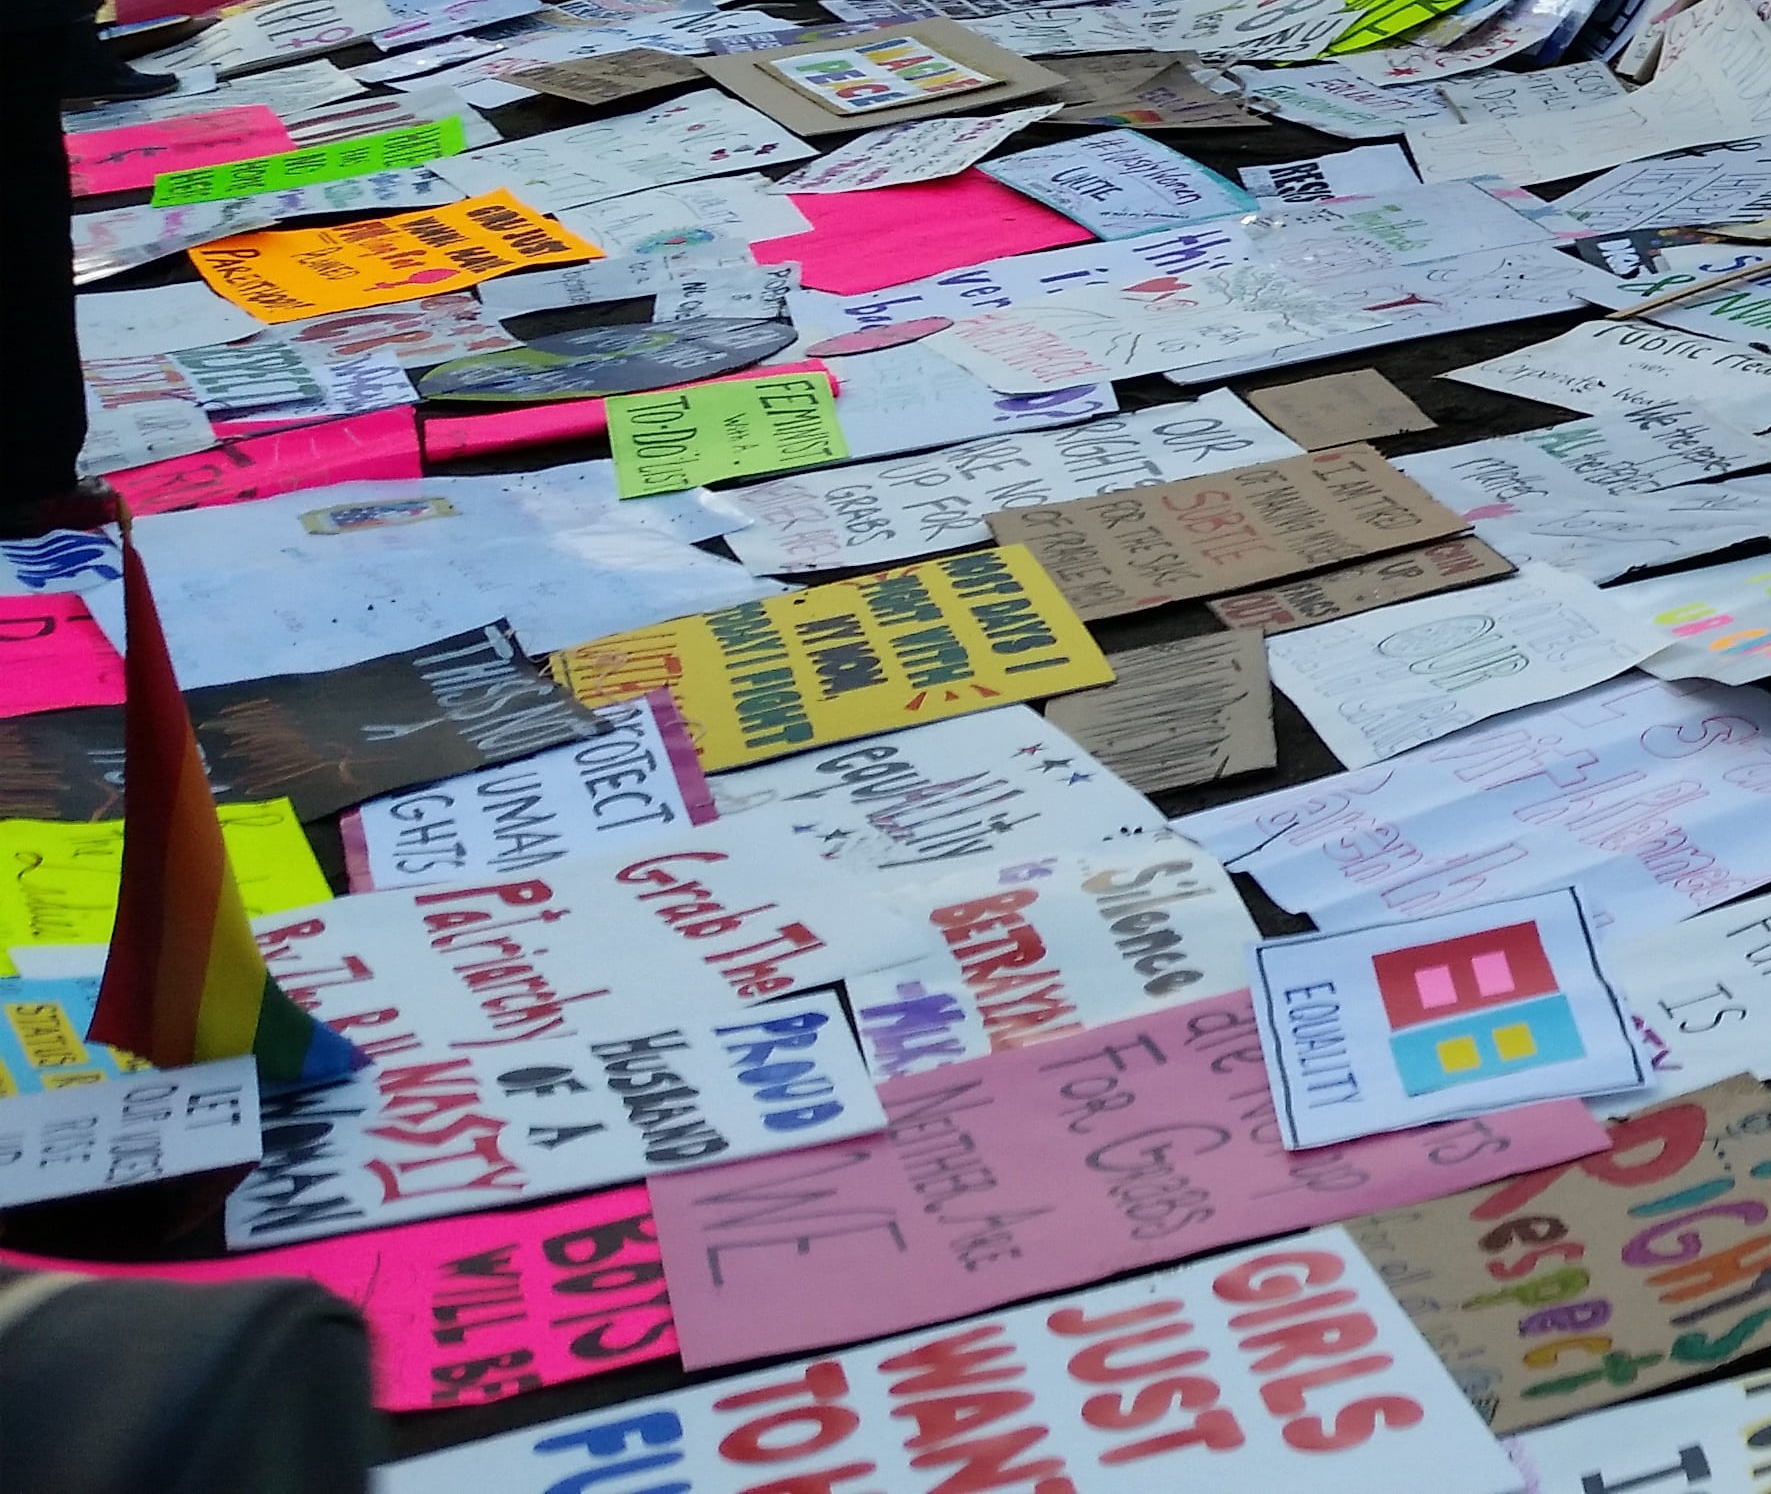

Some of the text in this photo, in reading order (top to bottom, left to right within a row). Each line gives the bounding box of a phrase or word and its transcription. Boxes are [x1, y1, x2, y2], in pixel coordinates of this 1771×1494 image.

[1050, 167, 1125, 203] UNITE
[755, 379, 833, 462] FEMINIST
[940, 437, 1032, 481] ARE
[1152, 417, 1254, 463] OUR
[824, 484, 896, 548] GRABS
[877, 461, 980, 542] UP FOR
[858, 574, 975, 689] FIGHT WITH
[936, 551, 1061, 656] MOST DAYS
[704, 601, 814, 747] TODAY FIGHT
[795, 613, 888, 702] MY MOM
[415, 878, 611, 1049] Patriarchy
[614, 851, 828, 1000] Grab The
[1083, 857, 1204, 1001] Silence
[1282, 979, 1364, 1108] EQUALITY
[1677, 980, 1748, 1037] IS
[497, 1064, 605, 1151] OF A
[590, 1029, 731, 1164] HUSBAND
[715, 1009, 845, 1134] PROUD
[1038, 1032, 1167, 1135] For
[690, 1156, 909, 1292] WE
[431, 1242, 547, 1345] WILL
[543, 1210, 676, 1358] BOYS
[1045, 1299, 1246, 1467] JUST
[1213, 1250, 1425, 1455] GIRLS
[712, 1360, 861, 1462] TO
